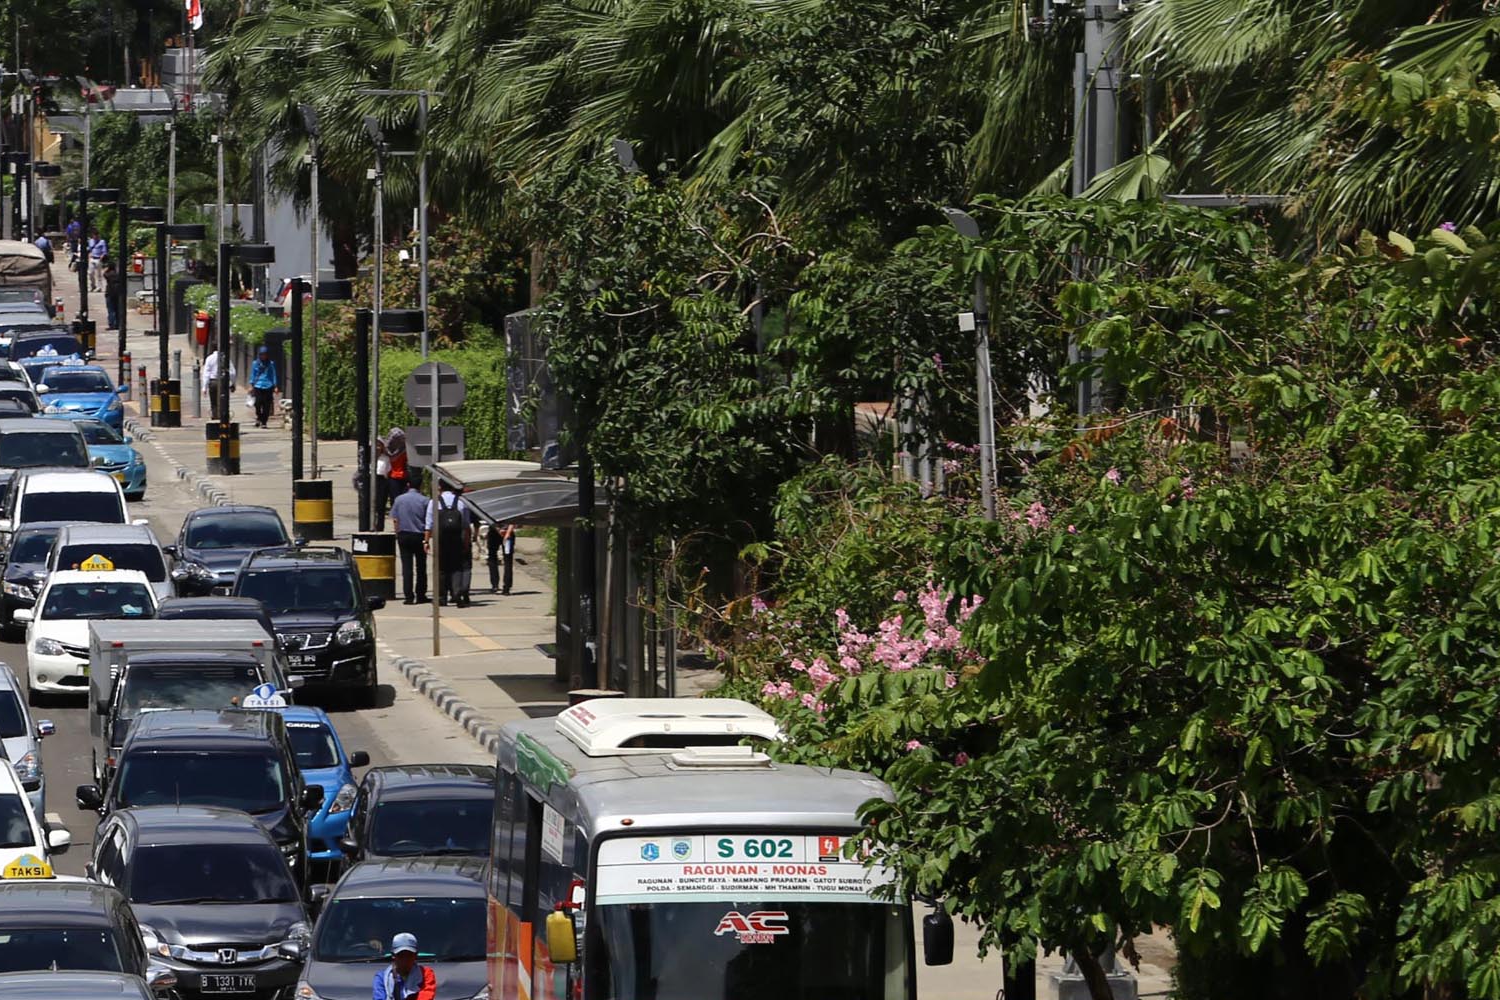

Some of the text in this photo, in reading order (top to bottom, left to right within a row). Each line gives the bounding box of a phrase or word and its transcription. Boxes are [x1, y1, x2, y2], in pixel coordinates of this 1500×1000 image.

[717, 838, 793, 858] S 602
[11, 867, 45, 876] TAKSI
[683, 866, 758, 875] RAGUNAN
[772, 866, 827, 875] MONAS
[714, 911, 790, 936] AC
